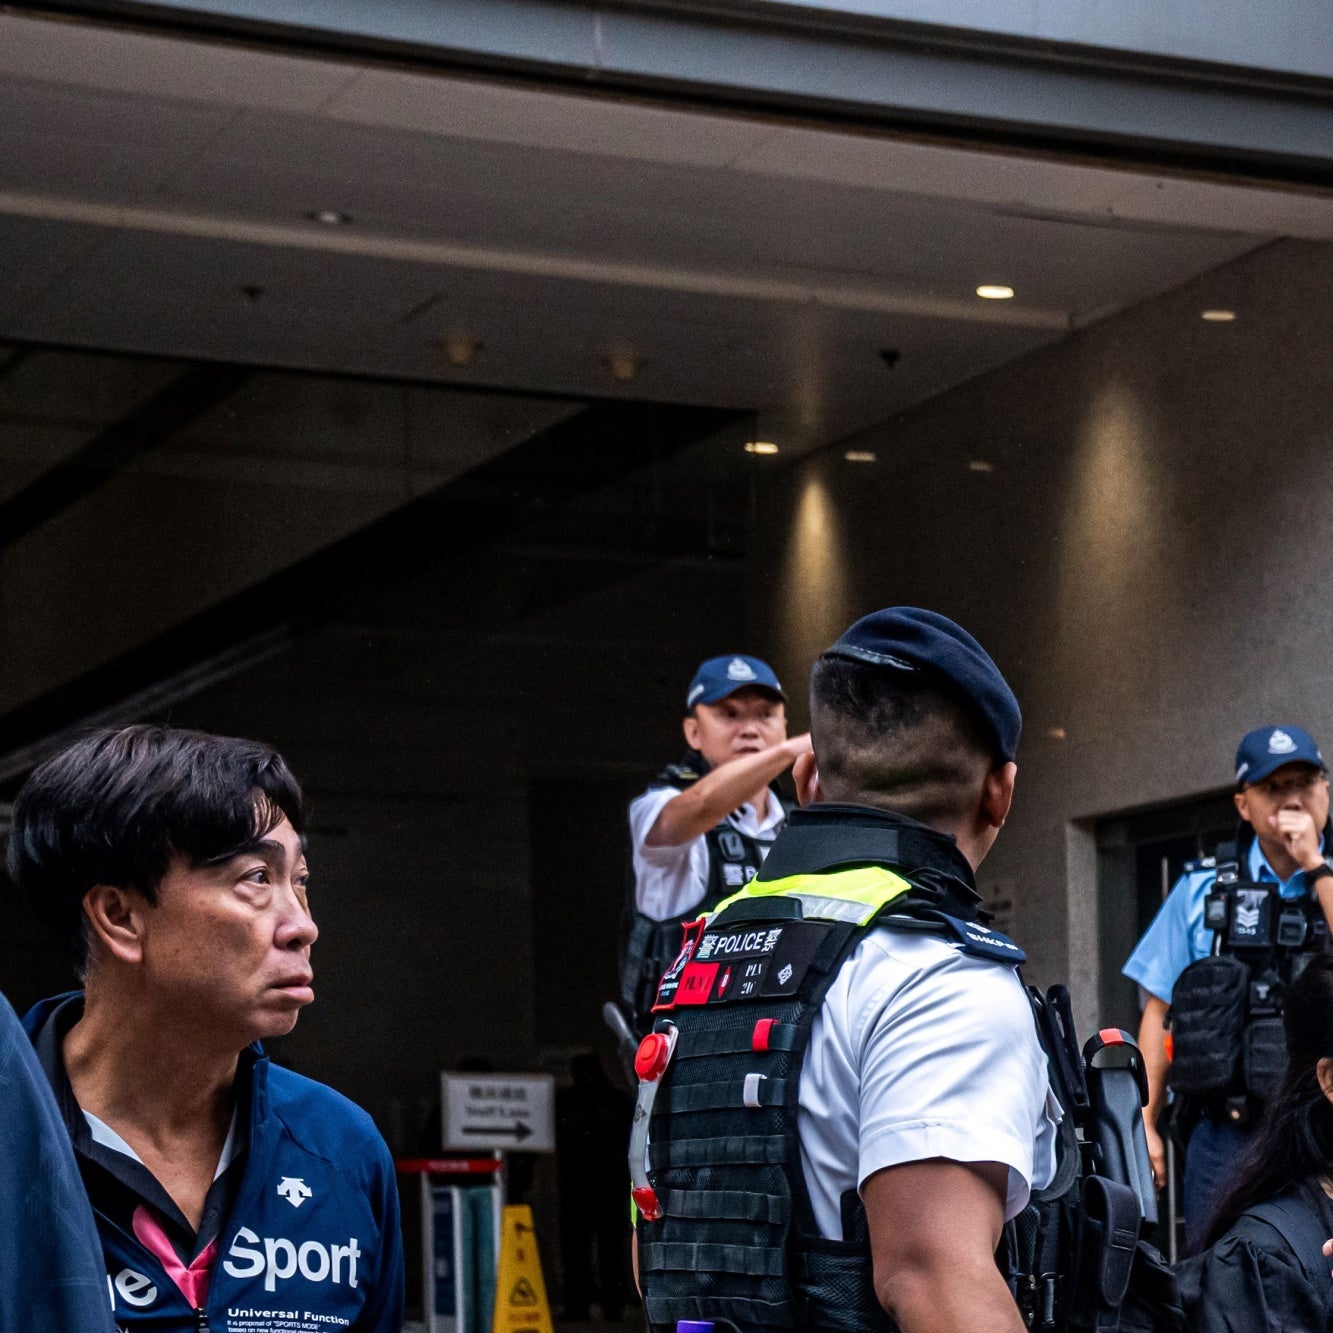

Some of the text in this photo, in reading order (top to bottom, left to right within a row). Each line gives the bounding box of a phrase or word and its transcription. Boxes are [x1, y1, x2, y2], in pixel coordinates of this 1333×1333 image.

[714, 931, 766, 955] POLICE
[222, 1226, 361, 1292] Sport
[227, 1308, 350, 1326] Universal Function
